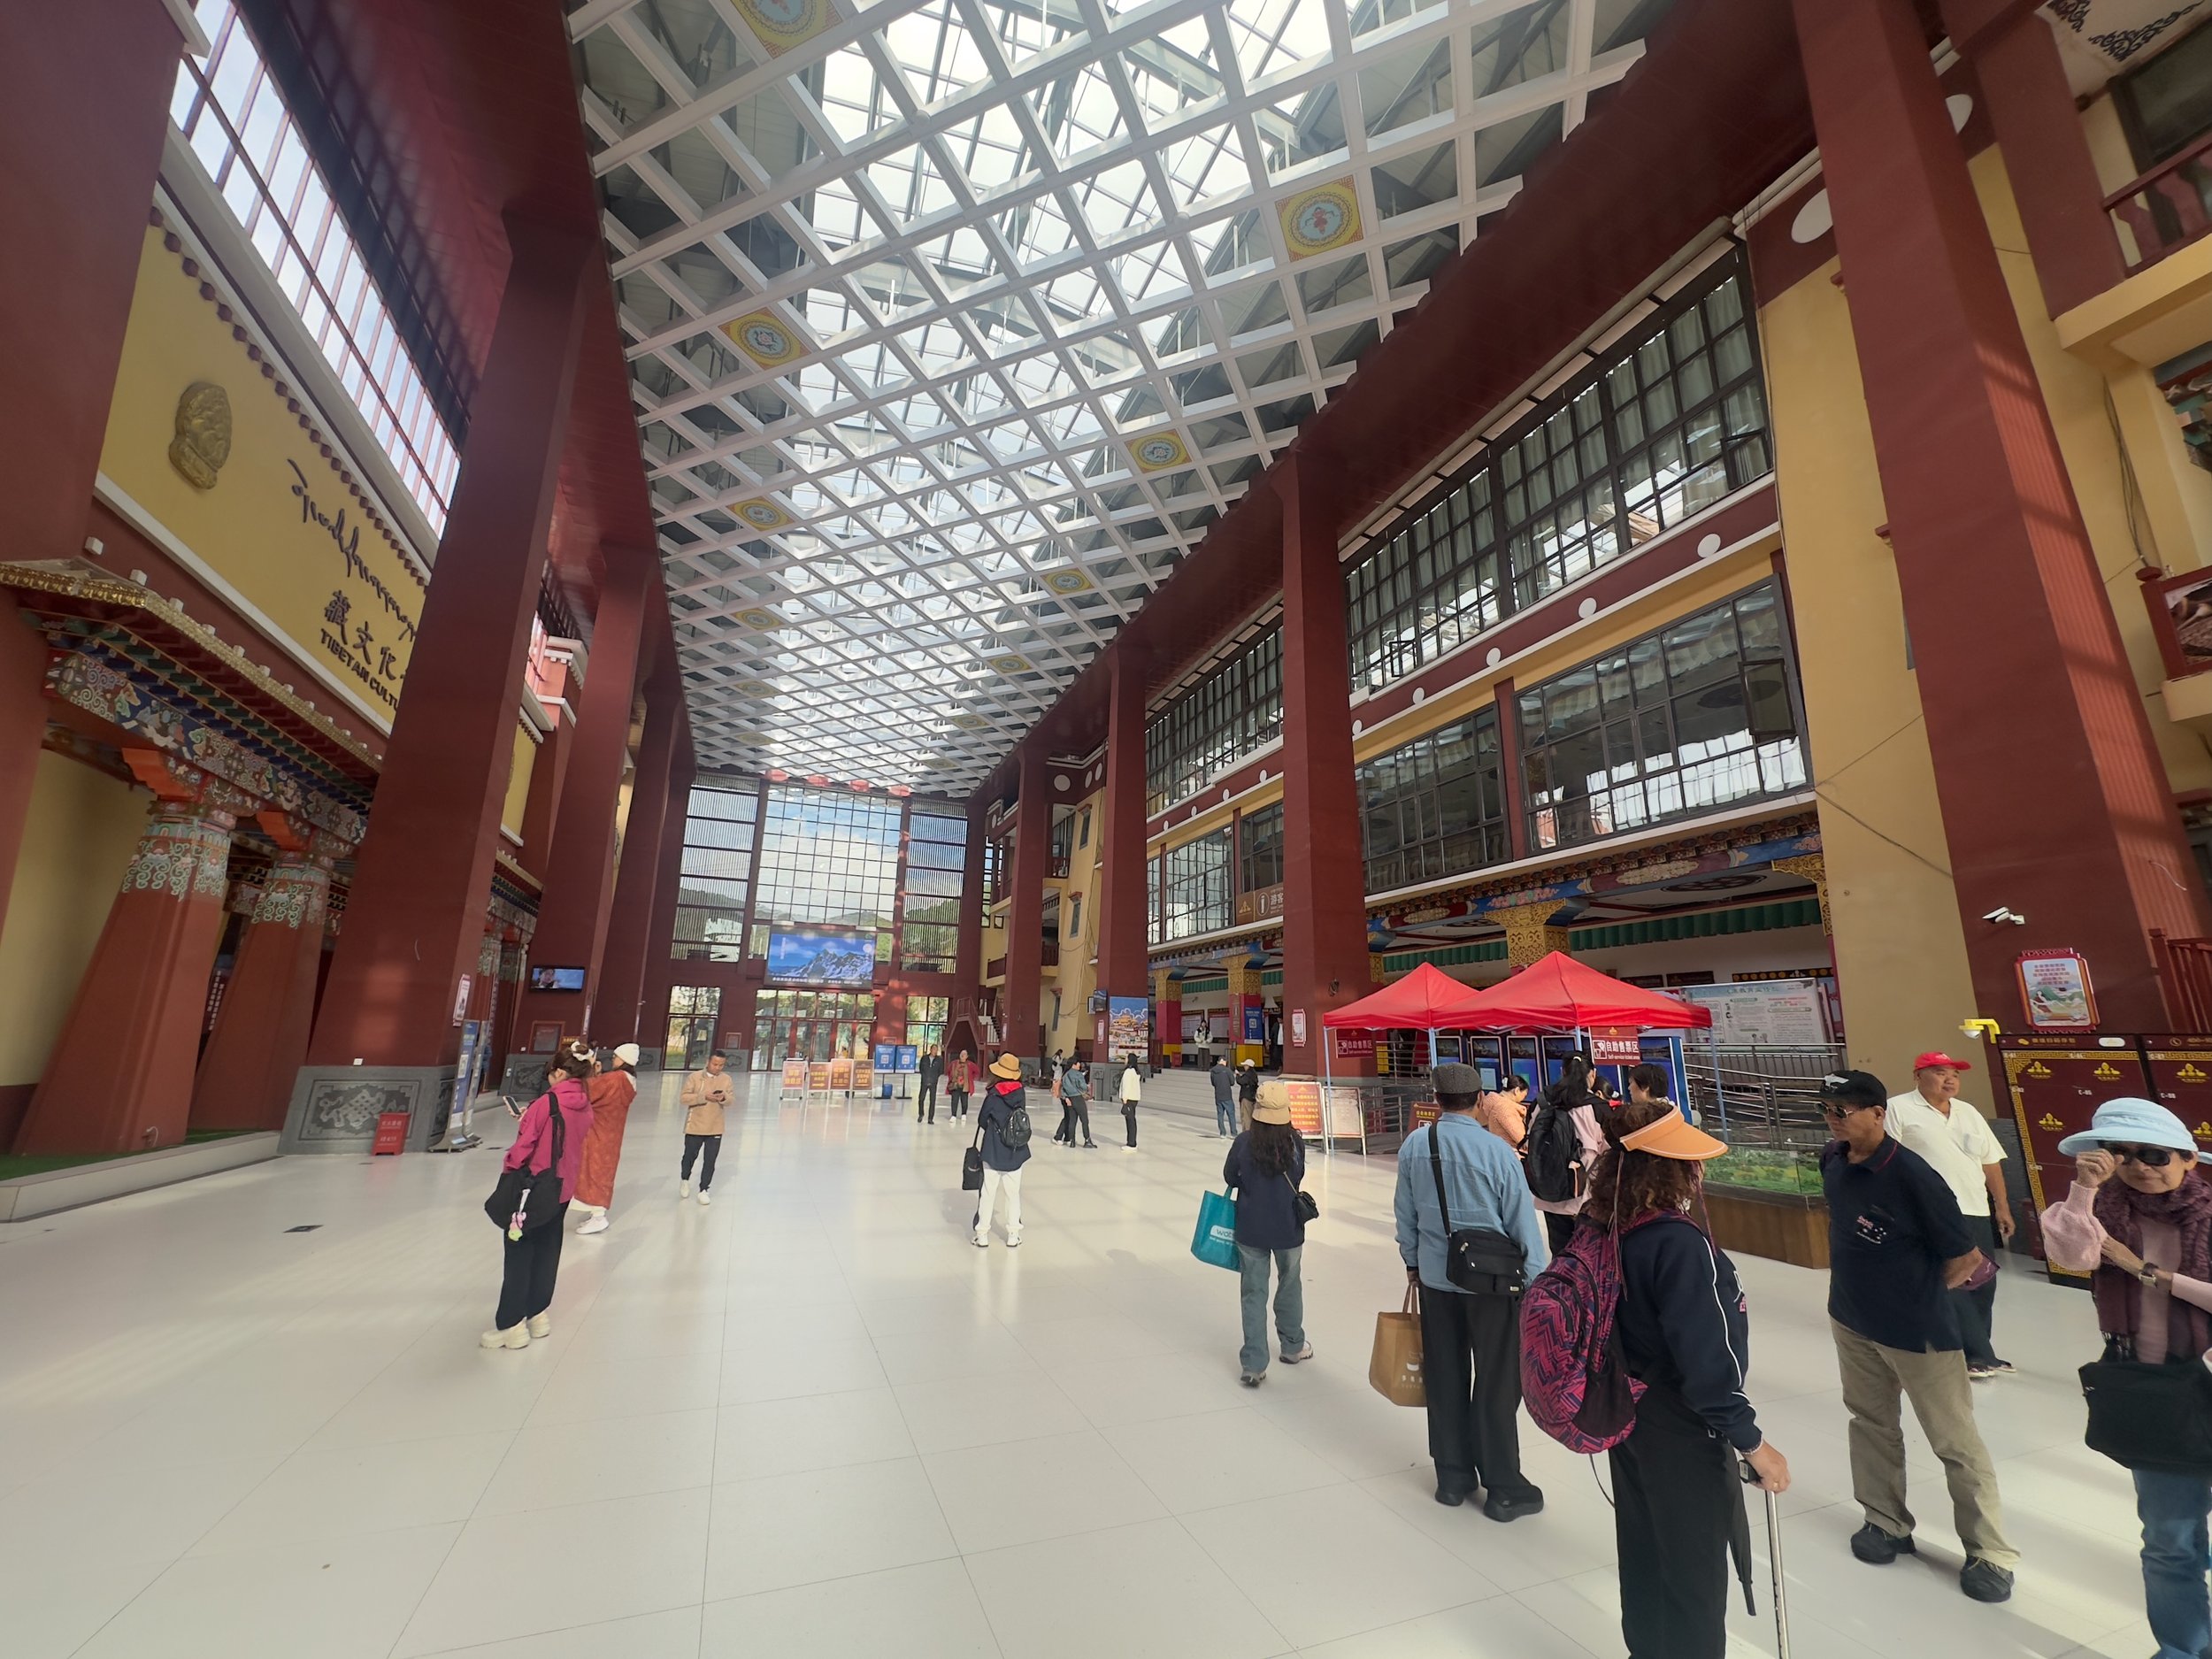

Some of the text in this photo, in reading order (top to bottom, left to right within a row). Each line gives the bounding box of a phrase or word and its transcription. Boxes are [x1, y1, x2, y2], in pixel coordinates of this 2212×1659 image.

[320, 627, 370, 683] TIBETAN
[325, 589, 406, 680] 藏文化
[1606, 1041, 1640, 1053] 自助售票区
